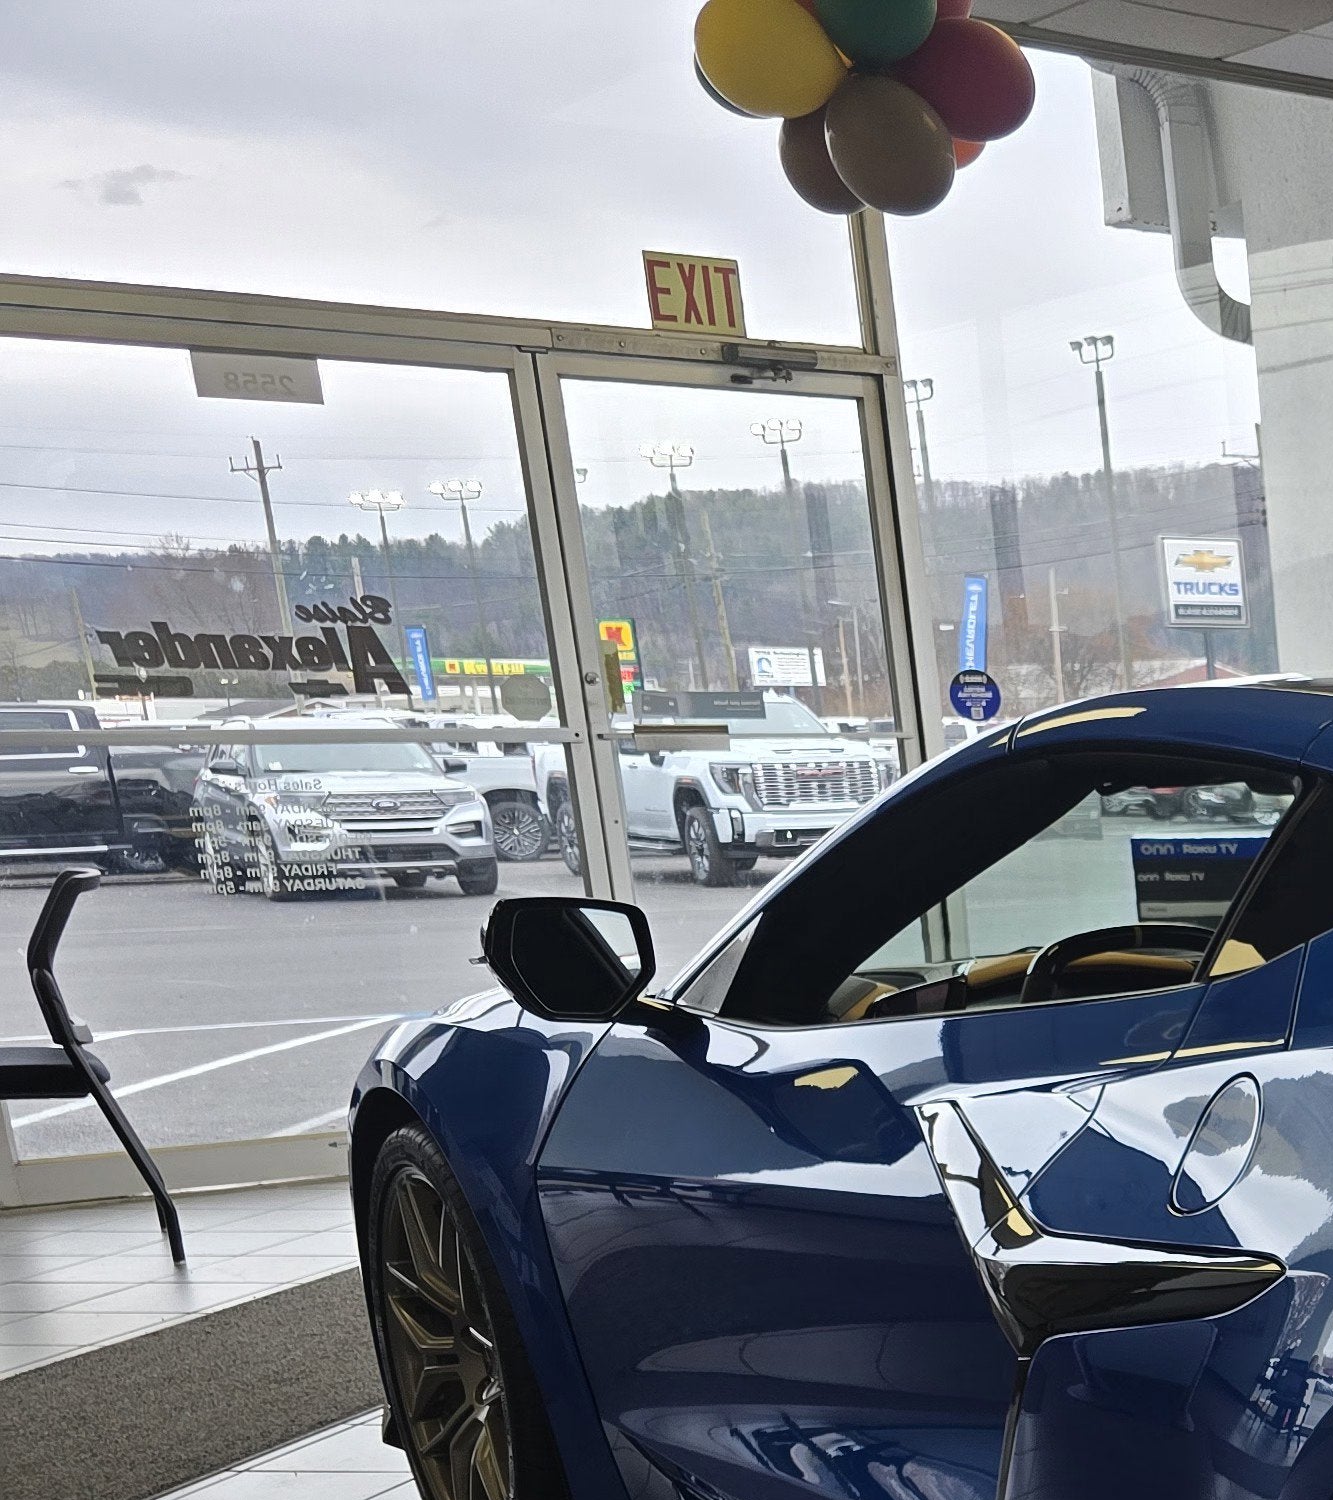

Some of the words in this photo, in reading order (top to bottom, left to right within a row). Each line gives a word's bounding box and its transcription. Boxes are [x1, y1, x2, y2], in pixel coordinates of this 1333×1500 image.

[646, 259, 736, 328] EXIT
[1173, 581, 1239, 596] TRUCKS
[1140, 843, 1175, 856] onn
[1182, 844, 1217, 854] Roku
[1220, 843, 1238, 854] TV
[1137, 873, 1160, 881] onn
[1191, 872, 1204, 881] TV
